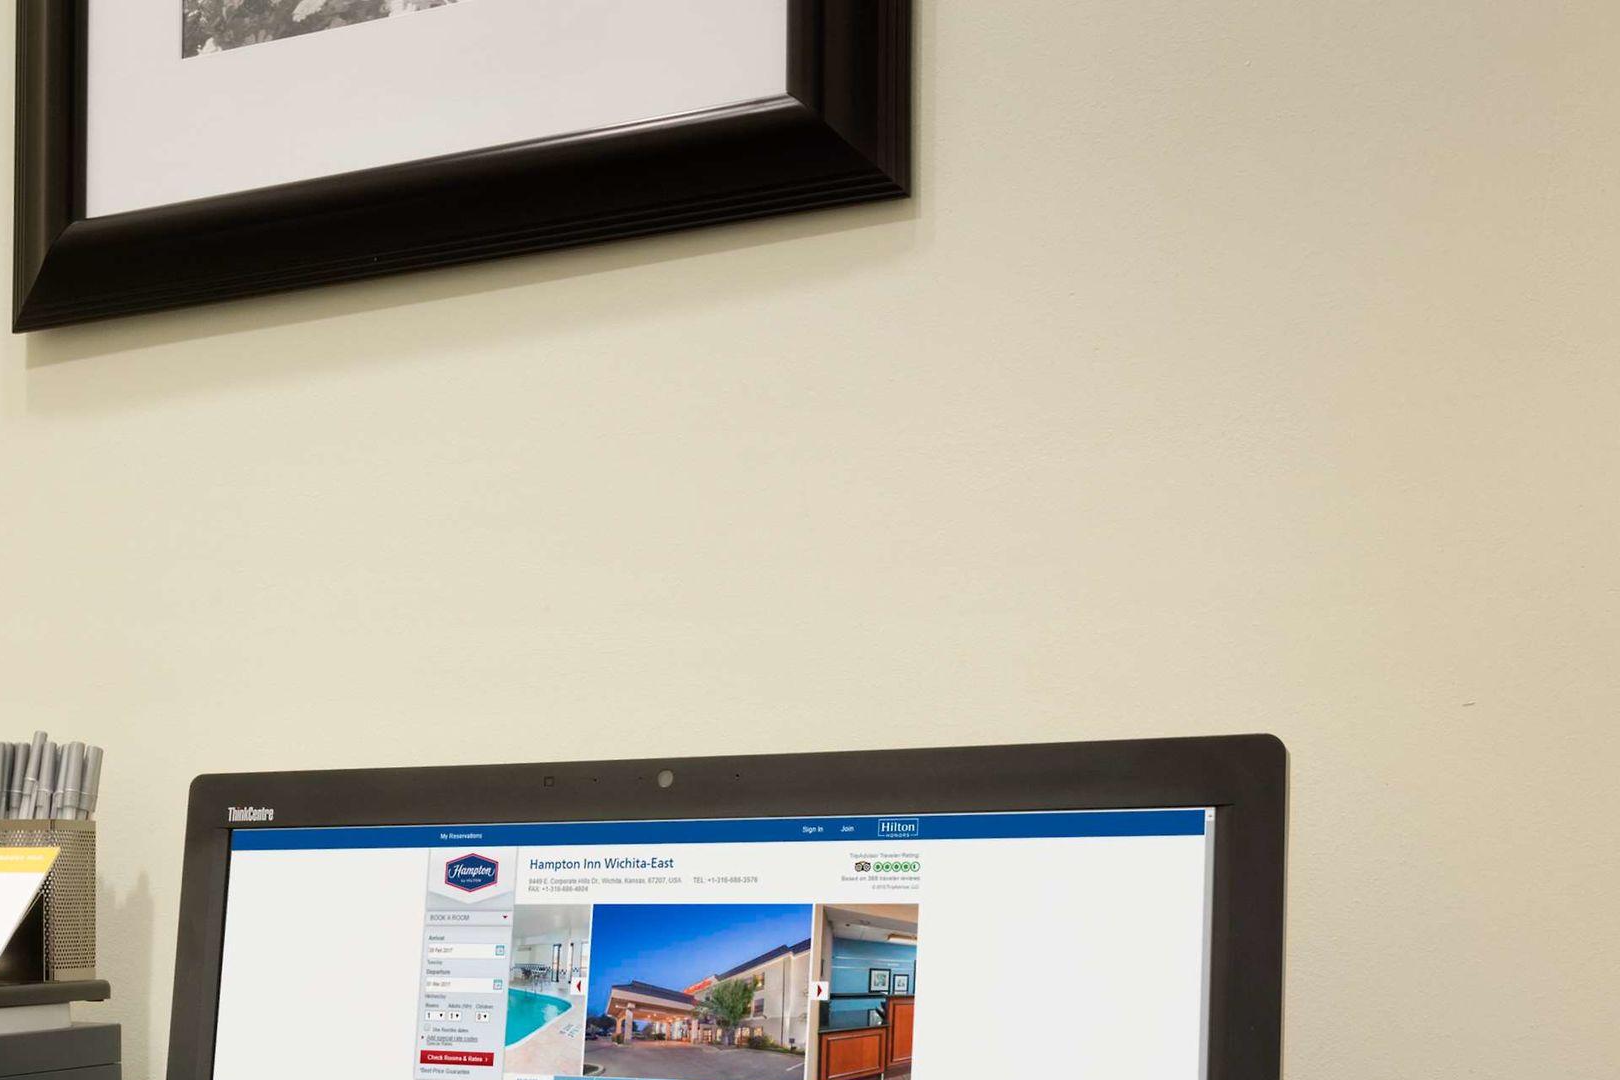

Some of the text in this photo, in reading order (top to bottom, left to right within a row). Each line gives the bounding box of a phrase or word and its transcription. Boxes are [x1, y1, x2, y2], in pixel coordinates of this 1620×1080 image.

[228, 807, 274, 821] ThinkCentre
[802, 825, 816, 834] Sign
[881, 822, 915, 832] Hilton
[448, 864, 495, 878] Hampton
[530, 857, 674, 872] Hampton Inn Wichita-East
